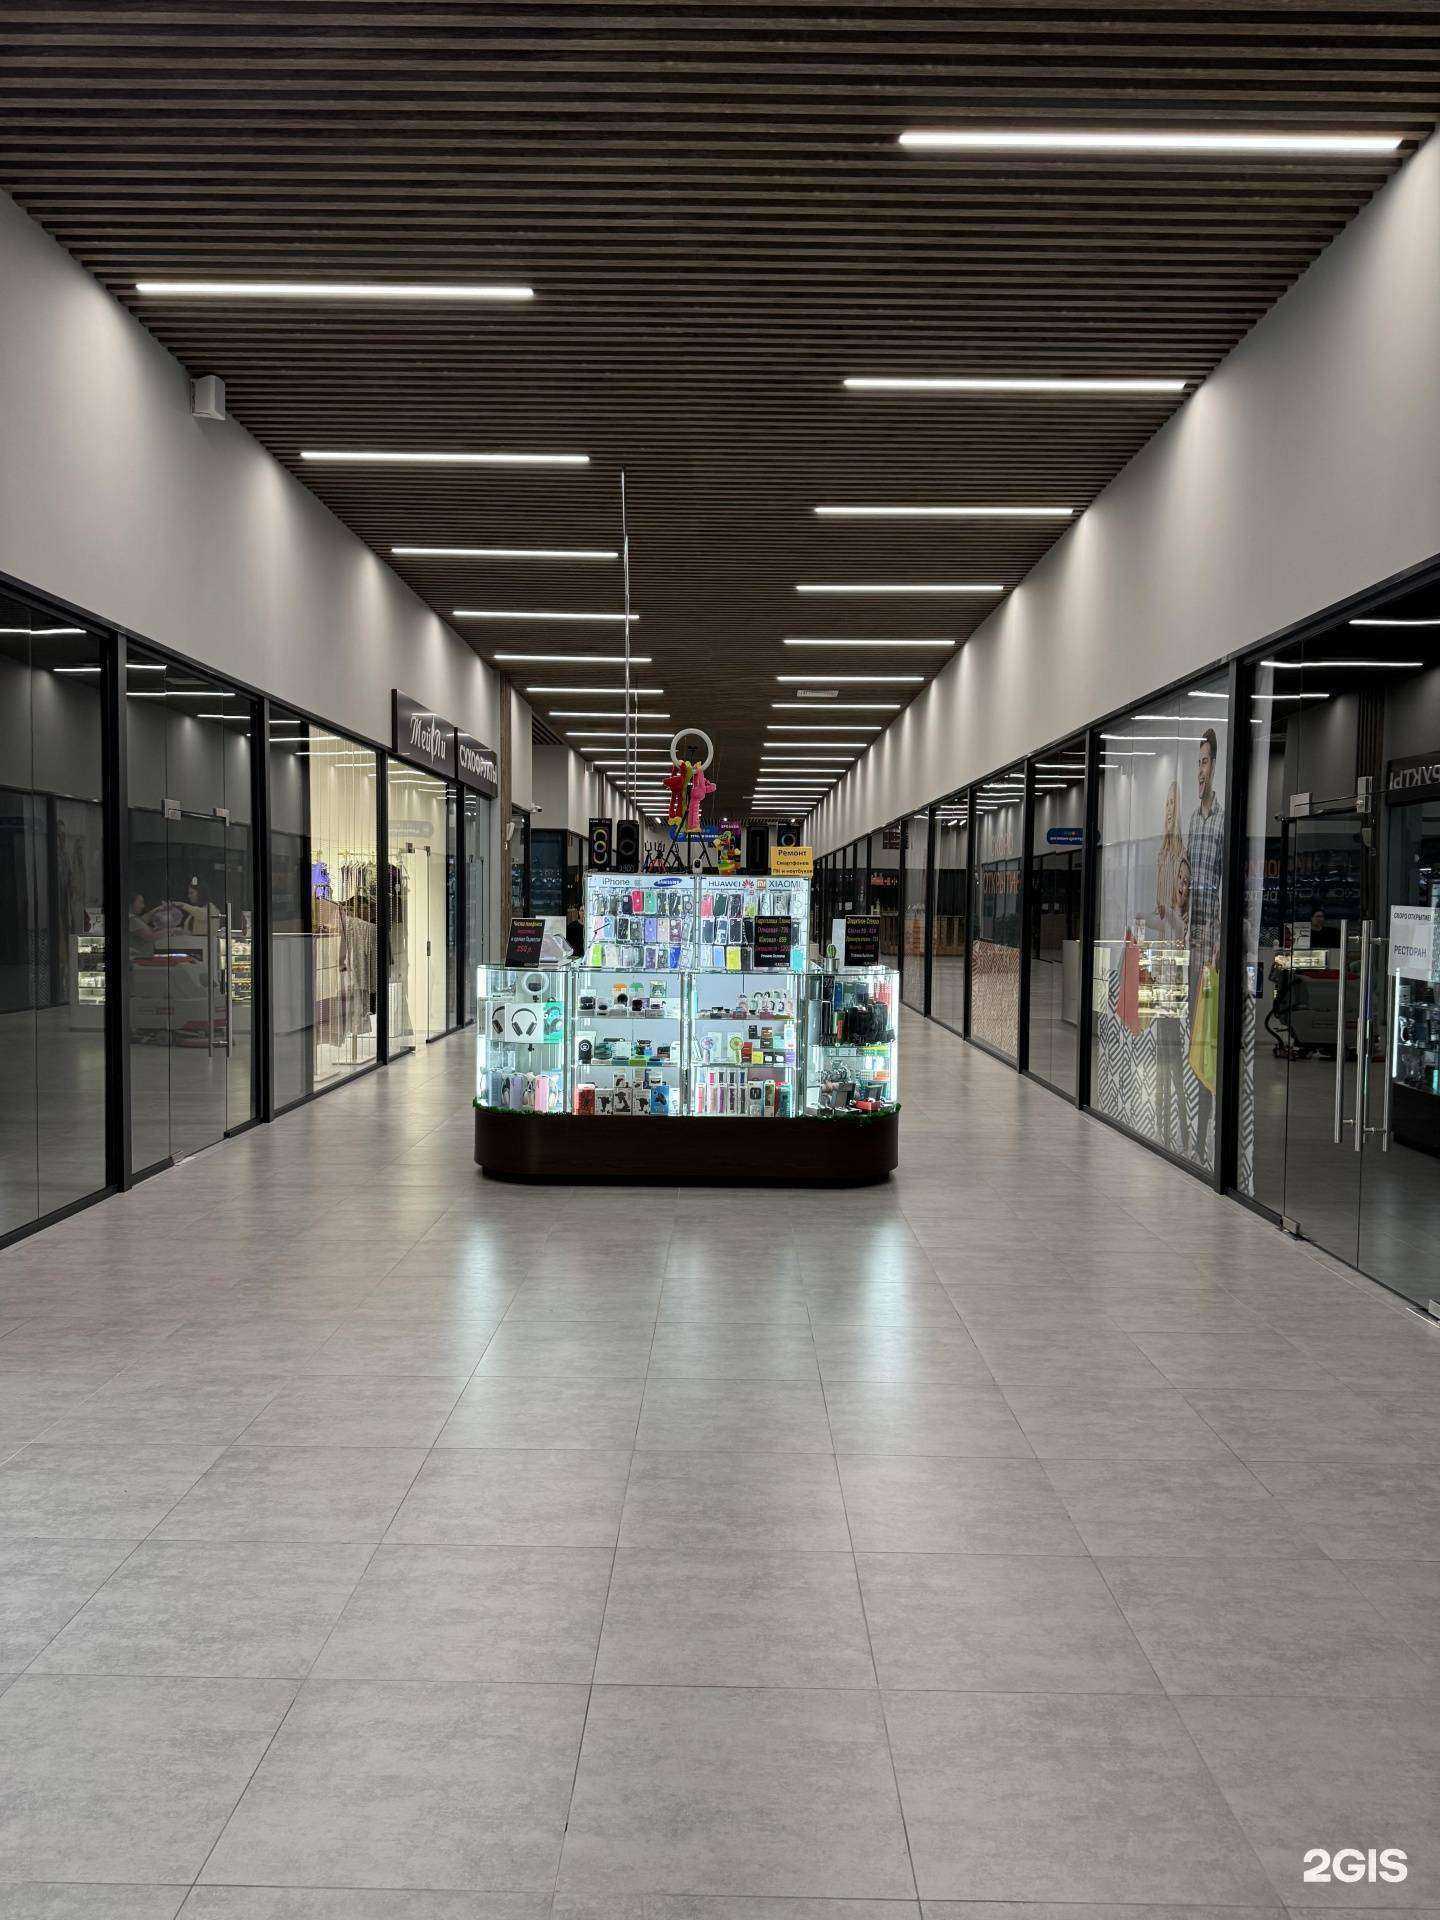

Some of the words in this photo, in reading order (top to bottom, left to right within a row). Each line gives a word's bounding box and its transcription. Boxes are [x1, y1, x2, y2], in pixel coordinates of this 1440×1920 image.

[778, 849, 807, 857] Ремонт
[602, 877, 630, 886] iPhone
[708, 880, 741, 888] HUAWEI
[768, 880, 801, 888] XIAOMI
[1393, 944, 1427, 958] РЕСТОРАН
